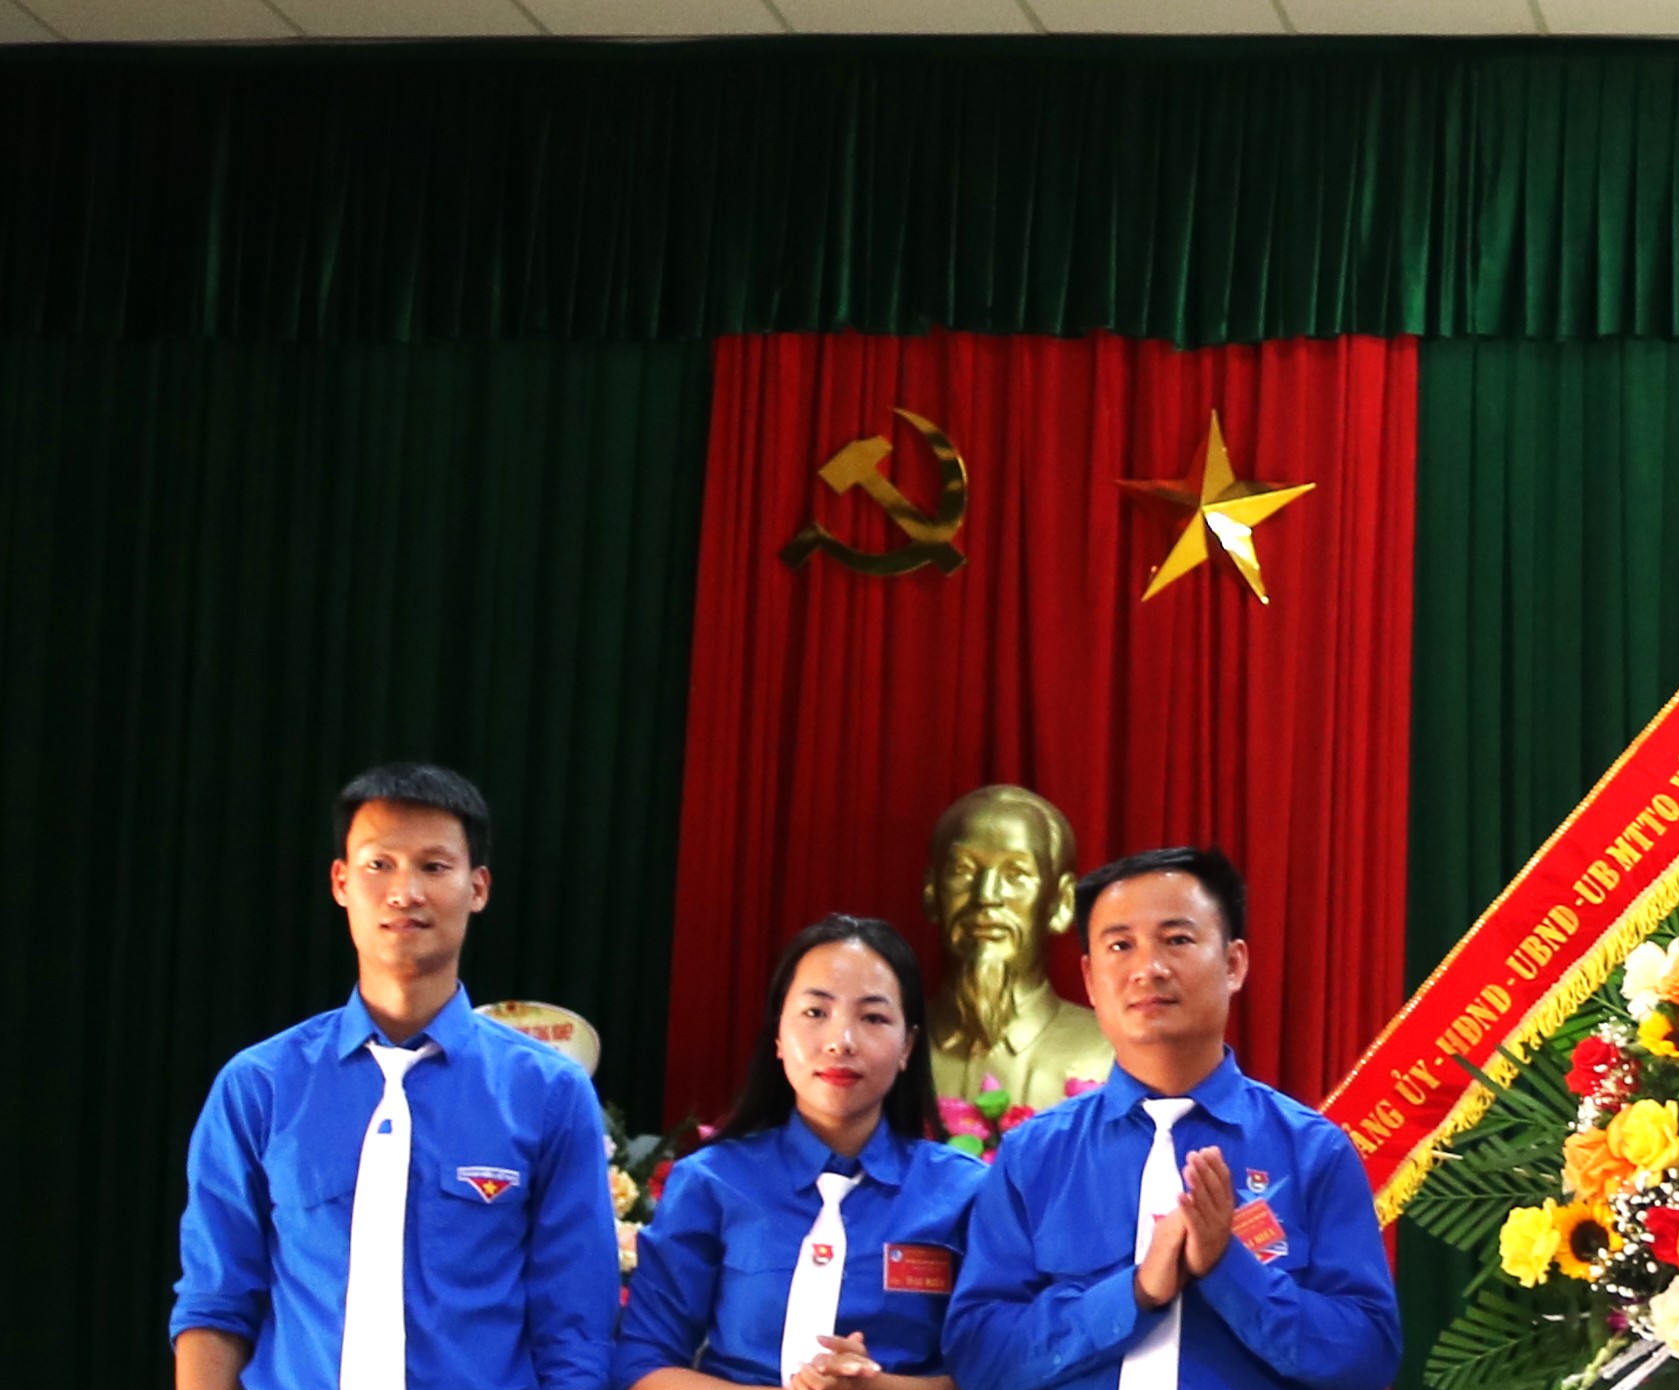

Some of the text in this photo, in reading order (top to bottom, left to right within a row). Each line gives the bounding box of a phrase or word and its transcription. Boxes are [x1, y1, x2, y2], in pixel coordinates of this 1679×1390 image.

[1341, 1099, 1405, 1160] ẢNG
[1391, 1052, 1441, 1106] ỦY
[1506, 904, 1580, 980] UBND
